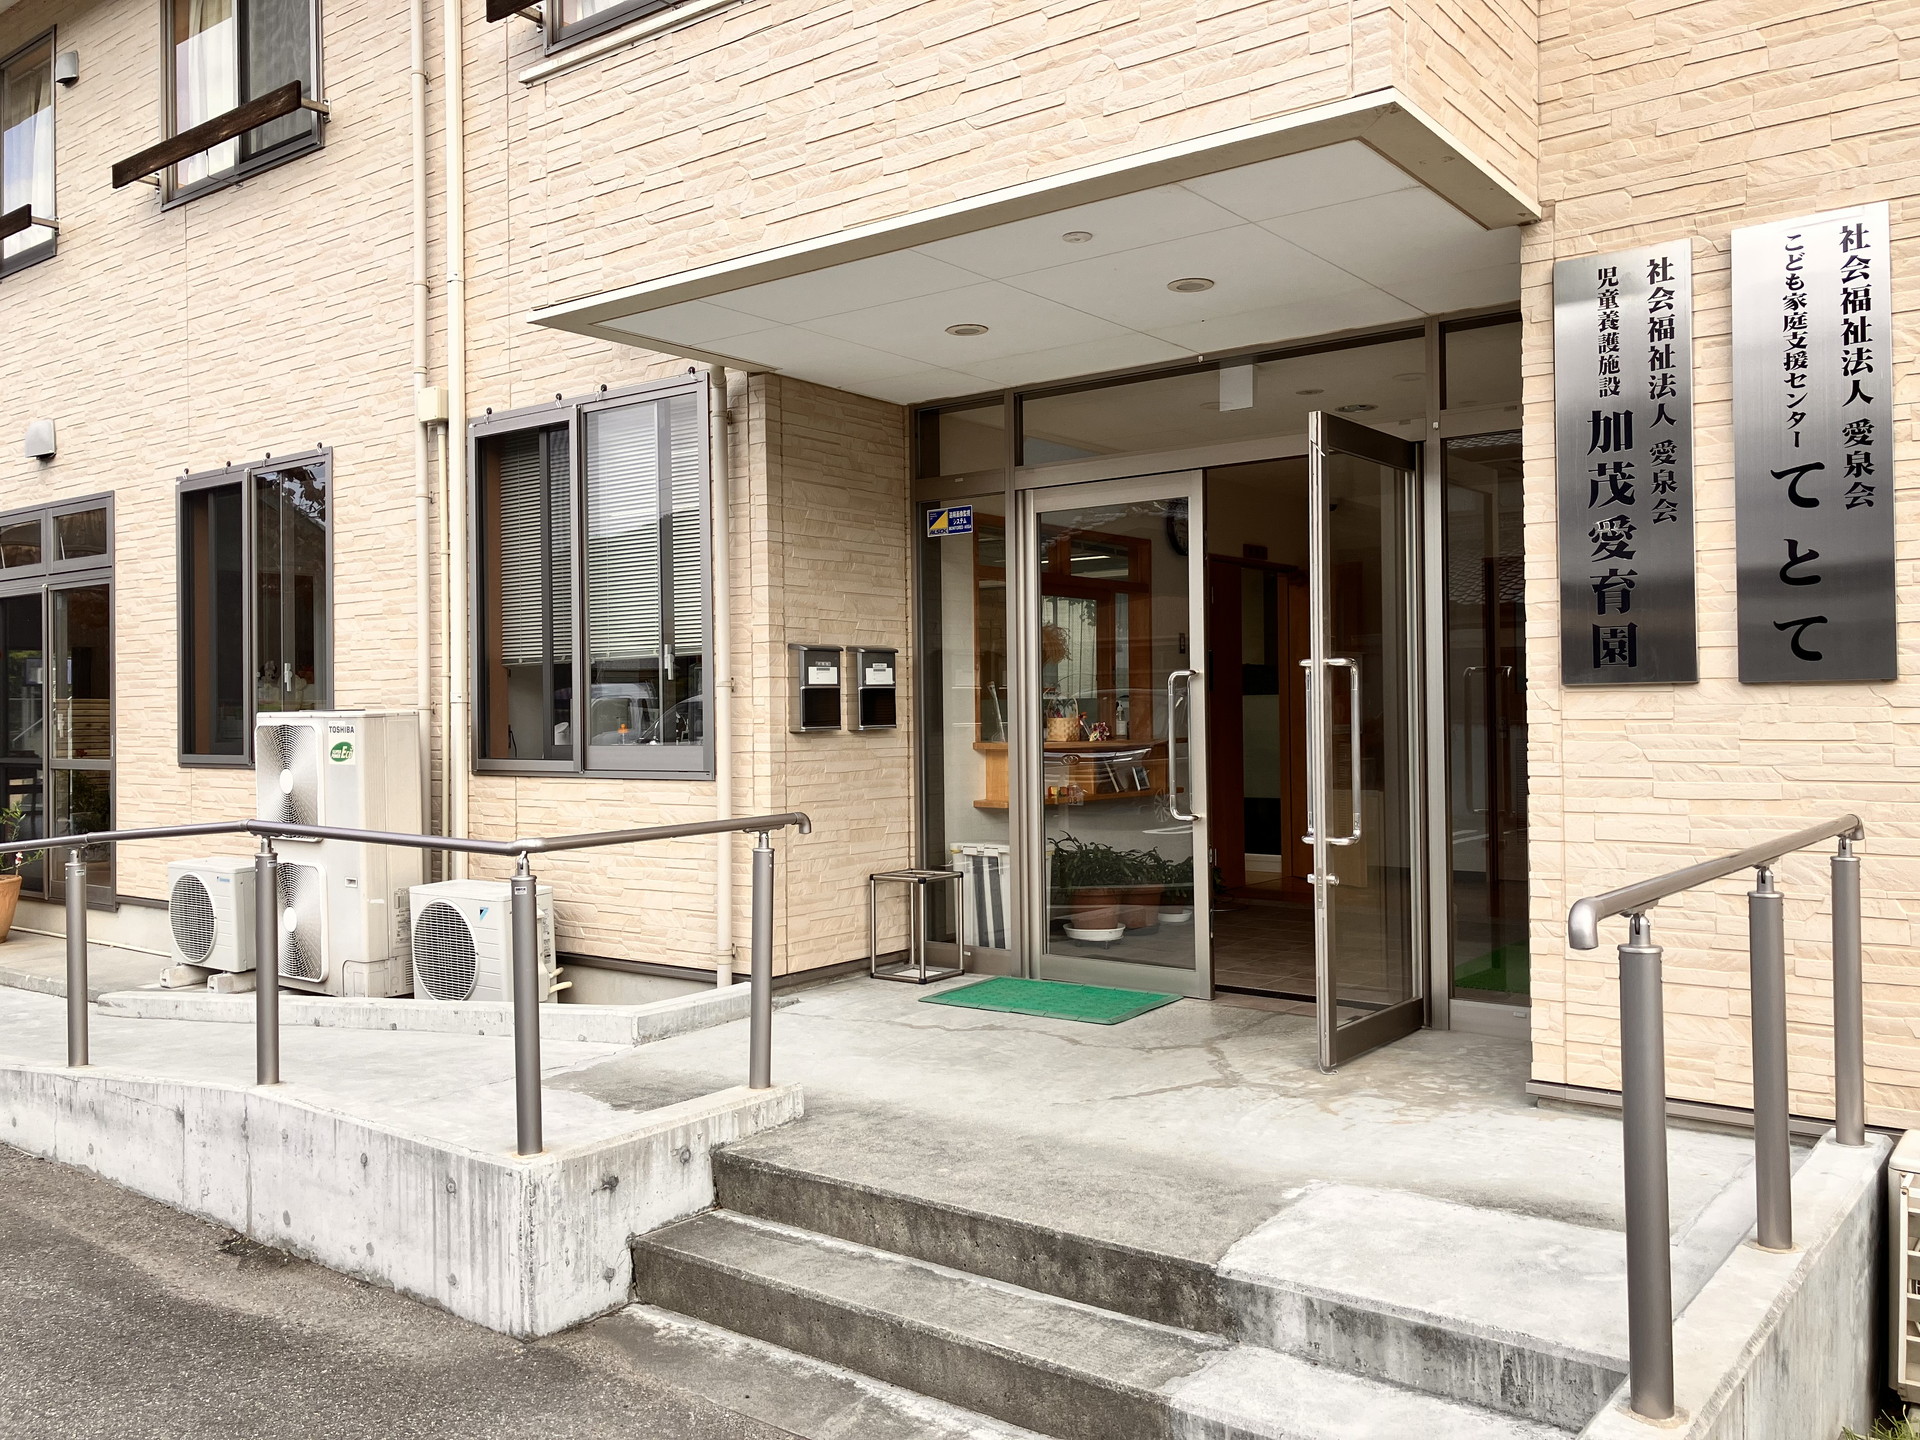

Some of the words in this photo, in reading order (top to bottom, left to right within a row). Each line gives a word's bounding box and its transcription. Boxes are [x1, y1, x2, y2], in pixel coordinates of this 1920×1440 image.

[1597, 266, 1621, 398] 児童養護施設
[1646, 257, 1677, 428] 社会福祉法人
[1782, 234, 1808, 448] こども家庭支援センター
[1839, 223, 1874, 407] 社会福祉法人
[1586, 409, 1638, 669] 加茂愛育園
[1649, 439, 1679, 524] 愛泉会
[1842, 418, 1876, 510] 愛泉会
[1770, 462, 1828, 661] てとて
